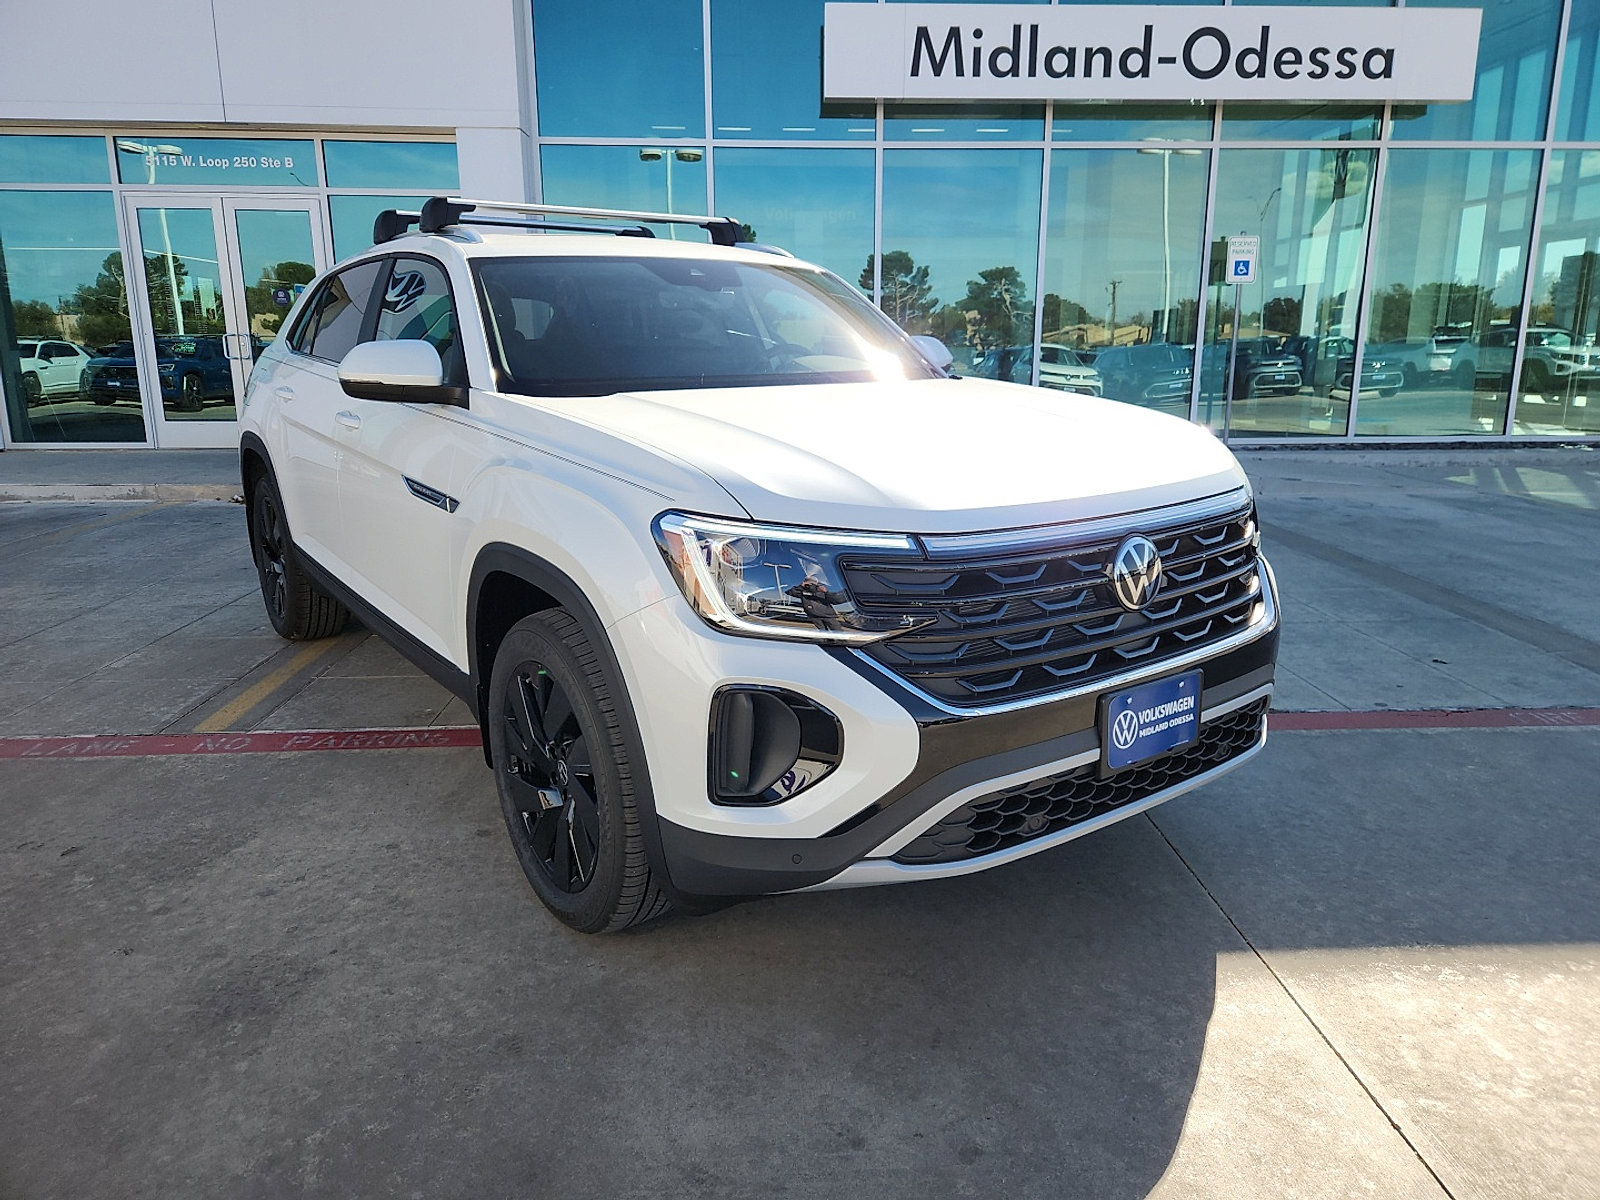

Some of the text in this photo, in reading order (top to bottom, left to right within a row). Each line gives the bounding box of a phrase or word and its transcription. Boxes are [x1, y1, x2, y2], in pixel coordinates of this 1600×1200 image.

[910, 24, 1396, 81] Midland-Odessa
[180, 156, 196, 167] W.
[199, 156, 230, 169] Loop
[233, 157, 257, 168] 250
[260, 157, 281, 168] Ste
[284, 157, 294, 168] B
[1138, 695, 1195, 725] VOLKSWAGEN
[1139, 713, 1195, 738] MIDLAND ODESSA
